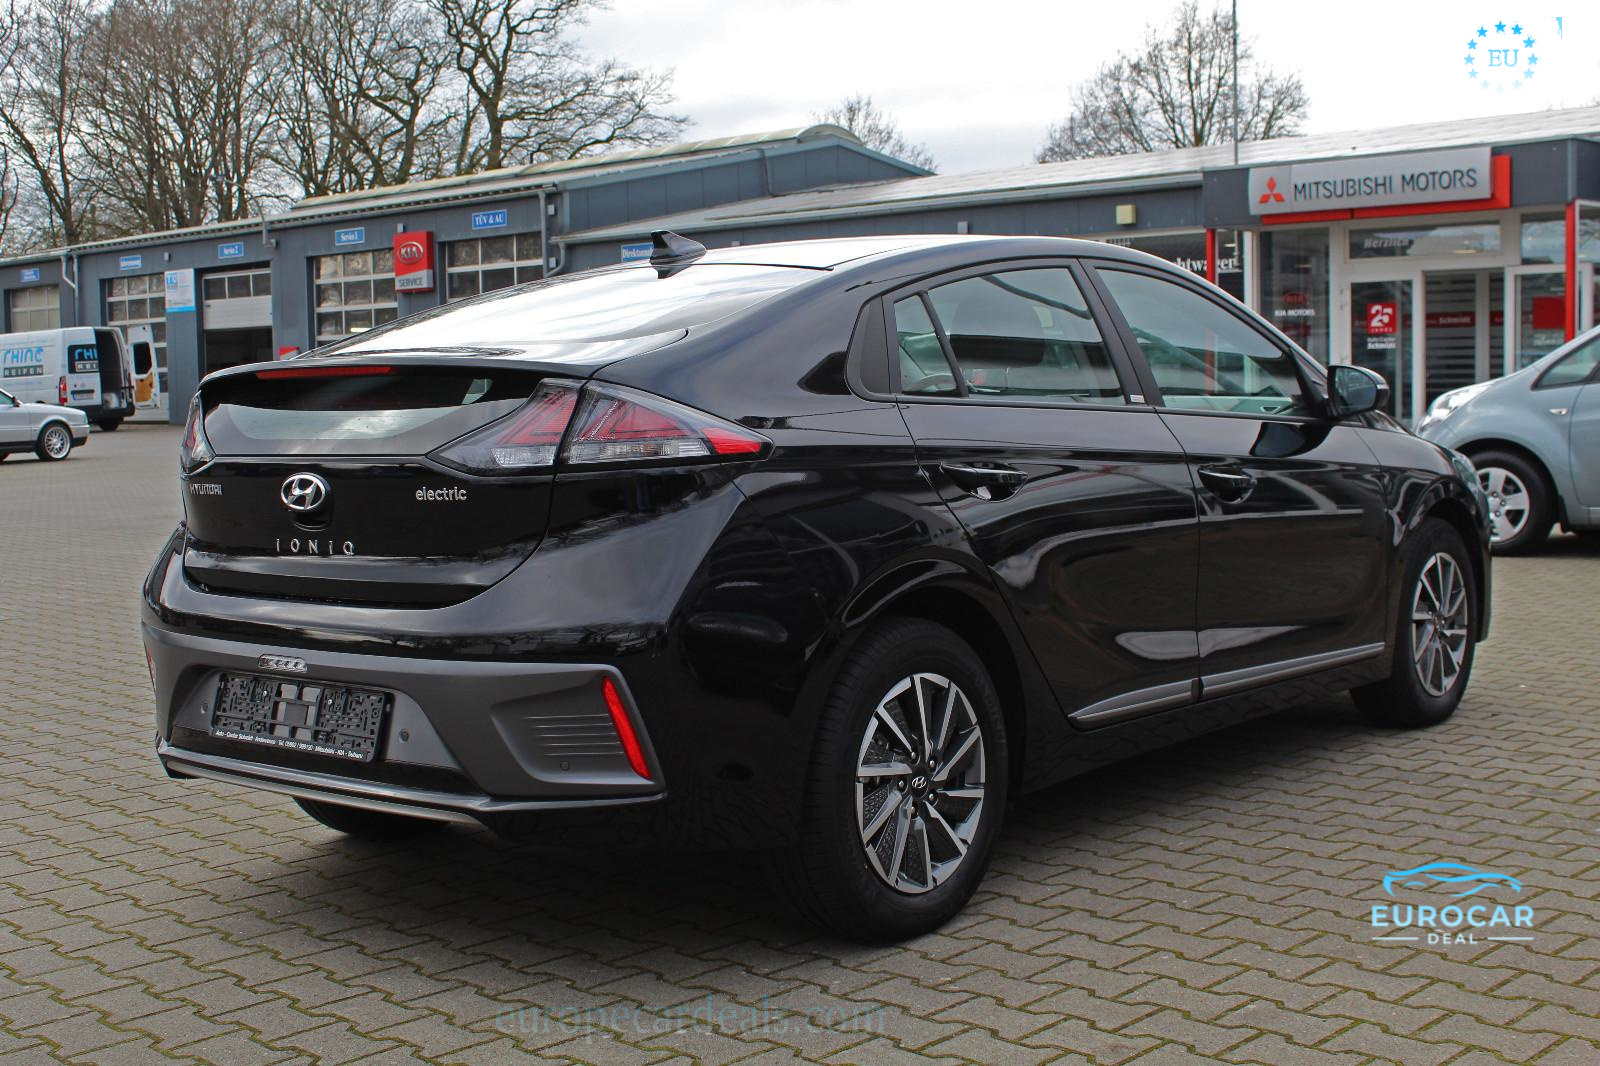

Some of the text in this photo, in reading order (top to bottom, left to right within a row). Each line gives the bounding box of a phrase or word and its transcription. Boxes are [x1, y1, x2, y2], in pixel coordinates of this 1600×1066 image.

[1294, 168, 1478, 200] MITSUBISHI MOTORS
[475, 214, 488, 225] TÜV
[496, 213, 505, 224] AU
[399, 277, 424, 287] SERVICE
[1370, 304, 1392, 328] 25
[1367, 342, 1396, 350] Schmidt
[4, 367, 43, 377] REIFEN
[190, 483, 223, 496] HYUNDAI
[415, 486, 468, 501] electric
[276, 538, 355, 556] IONIQ
